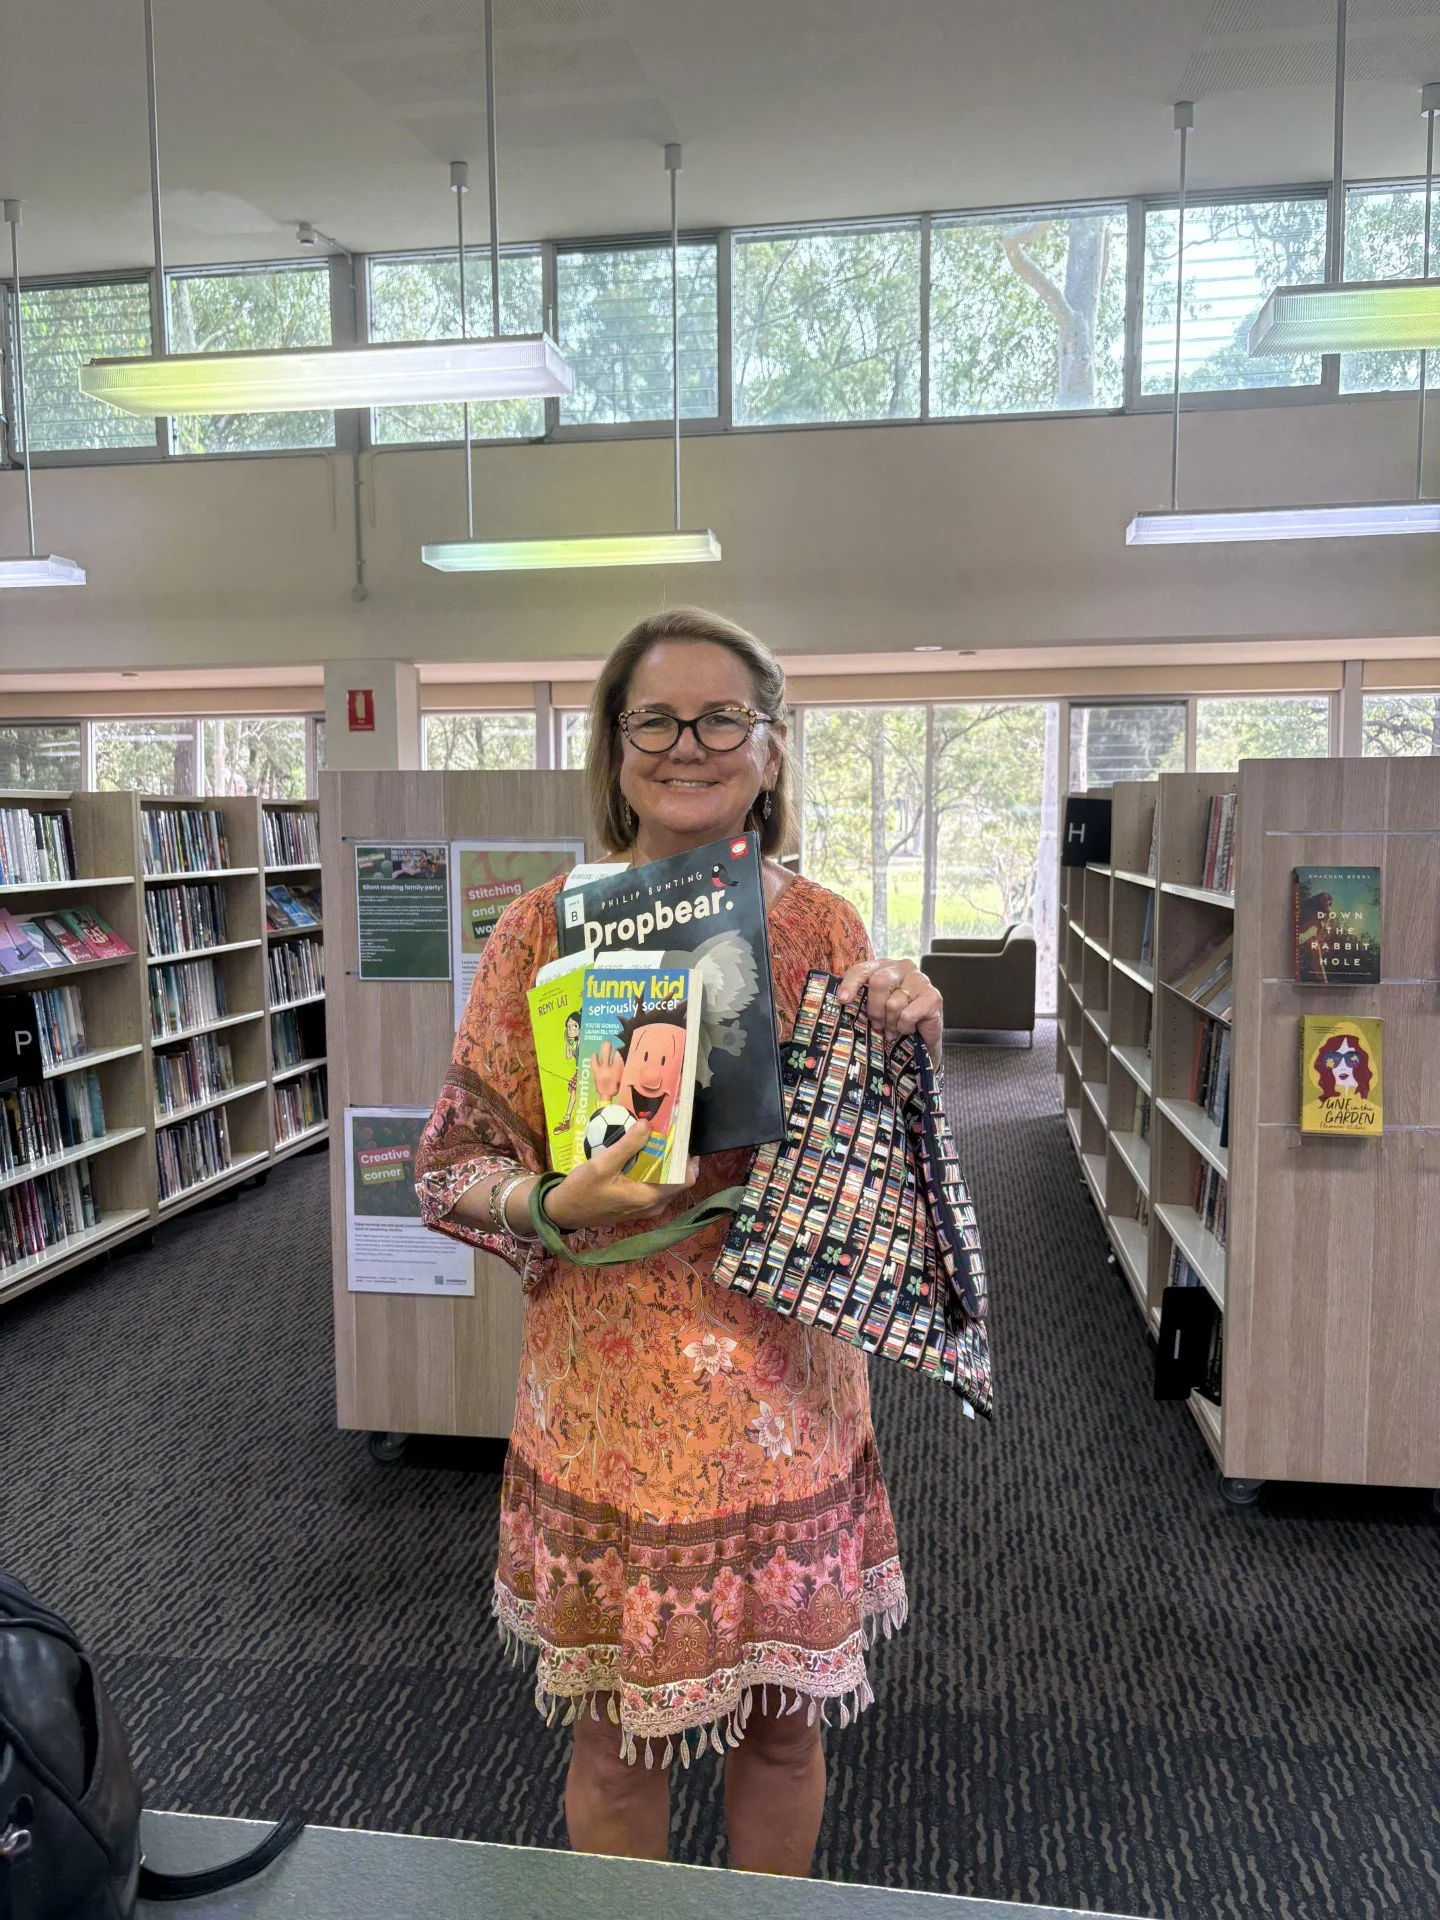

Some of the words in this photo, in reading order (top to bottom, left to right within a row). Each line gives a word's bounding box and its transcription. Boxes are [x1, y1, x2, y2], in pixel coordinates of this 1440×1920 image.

[1068, 822, 1086, 843] H
[380, 884, 404, 892] reading
[404, 884, 424, 892] family
[468, 884, 522, 901] Stitching
[601, 891, 640, 910] PHILIP
[648, 871, 703, 896] BUNTING
[471, 904, 496, 917] and
[571, 911, 579, 922] B
[1317, 911, 1363, 920] DOWN
[583, 889, 734, 950] Dropbear.
[1326, 927, 1355, 935] THE
[1311, 942, 1370, 951] RABBIT
[1320, 957, 1361, 966] HOLE
[586, 974, 646, 999] funny
[650, 974, 685, 999] kid
[538, 1000, 554, 1017] REMY
[556, 994, 568, 1008] LAI
[588, 999, 639, 1017] seriously
[642, 999, 680, 1011] soccer
[15, 1030, 33, 1056] P
[576, 1057, 592, 1125] Stanton
[1318, 1098, 1352, 1110] JUNE
[1325, 1110, 1375, 1124] GARDEN
[360, 1149, 411, 1164] Creative
[363, 1167, 402, 1181] corner
